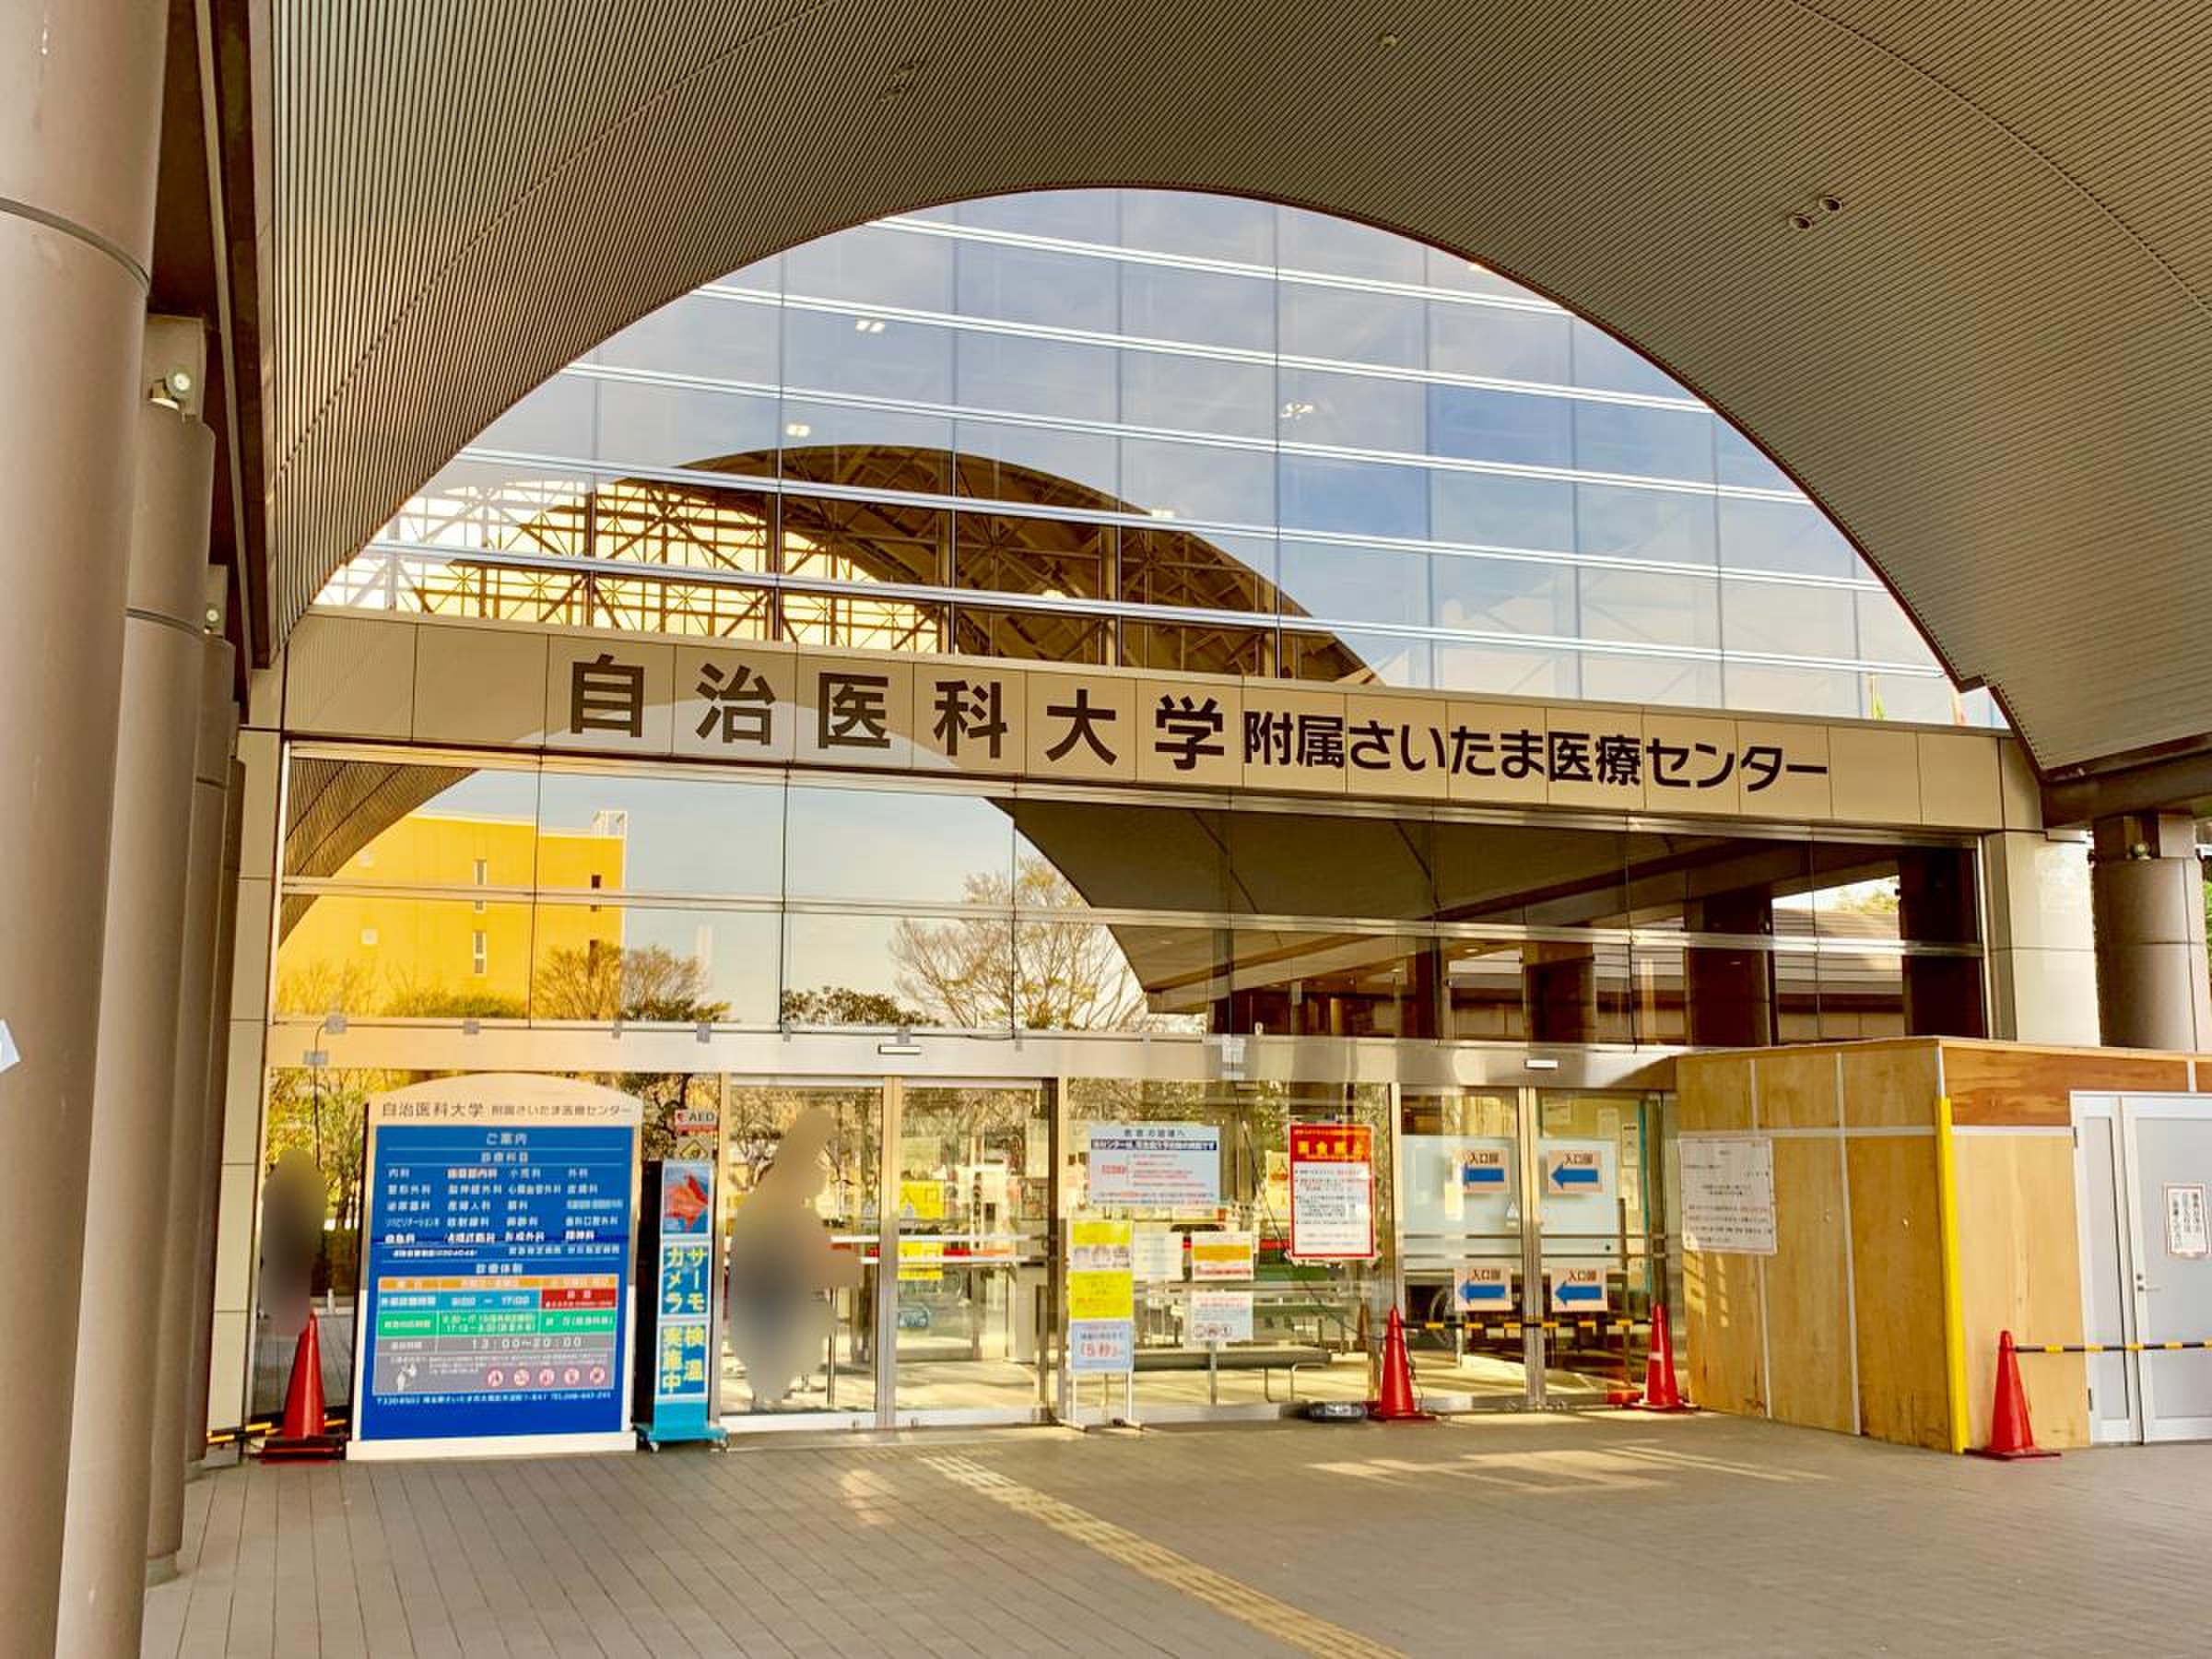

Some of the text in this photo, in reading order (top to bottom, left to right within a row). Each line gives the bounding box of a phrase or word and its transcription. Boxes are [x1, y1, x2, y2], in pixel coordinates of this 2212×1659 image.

[570, 653, 1224, 771] 自治医科大学
[1243, 711, 1829, 793] 附属さいたま医療センター
[664, 1246, 684, 1313] カメラ
[687, 1247, 708, 1312] サーモ
